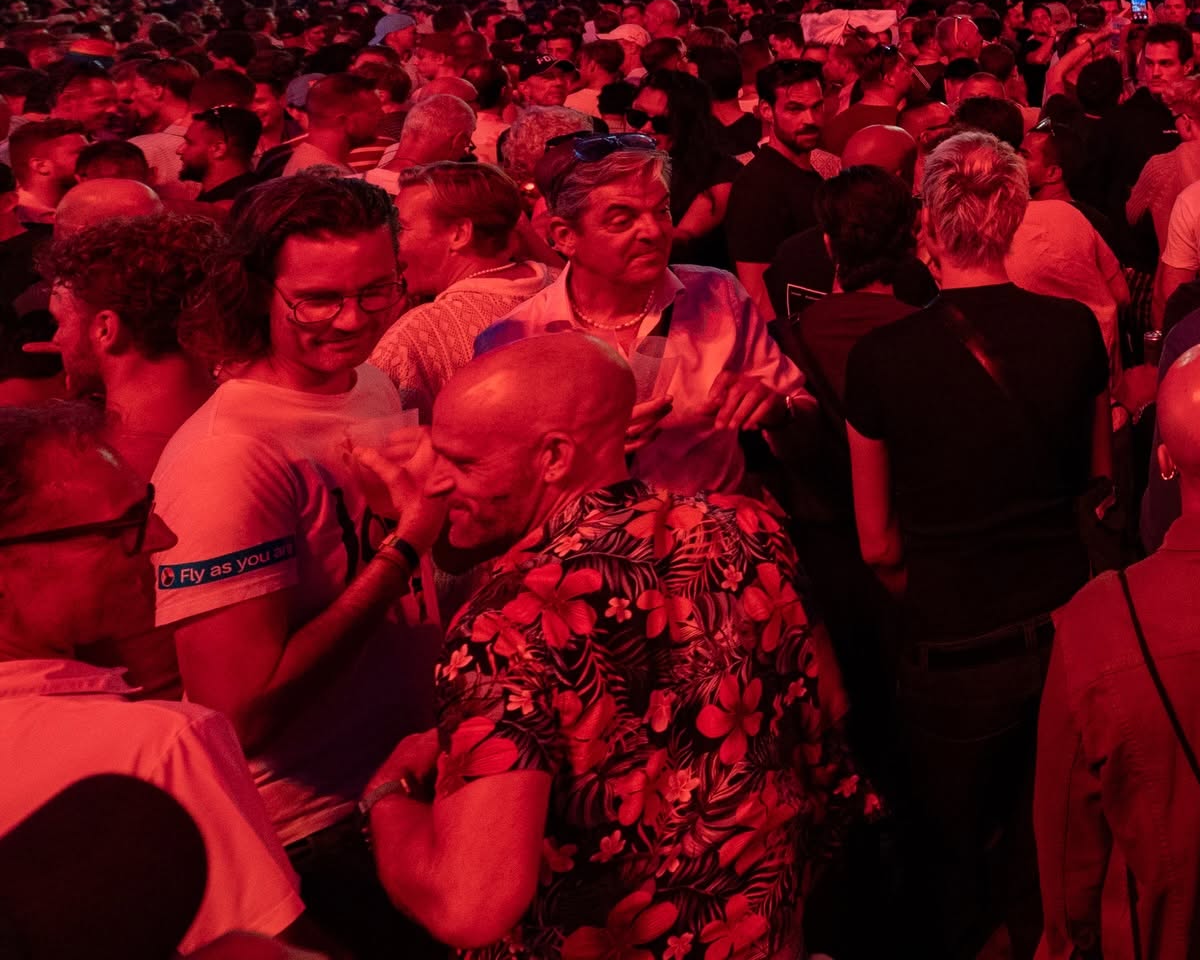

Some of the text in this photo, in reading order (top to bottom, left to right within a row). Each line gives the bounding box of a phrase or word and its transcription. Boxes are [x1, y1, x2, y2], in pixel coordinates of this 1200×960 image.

[180, 568, 206, 584] Fly
[210, 562, 233, 577] as
[236, 552, 270, 573] you
